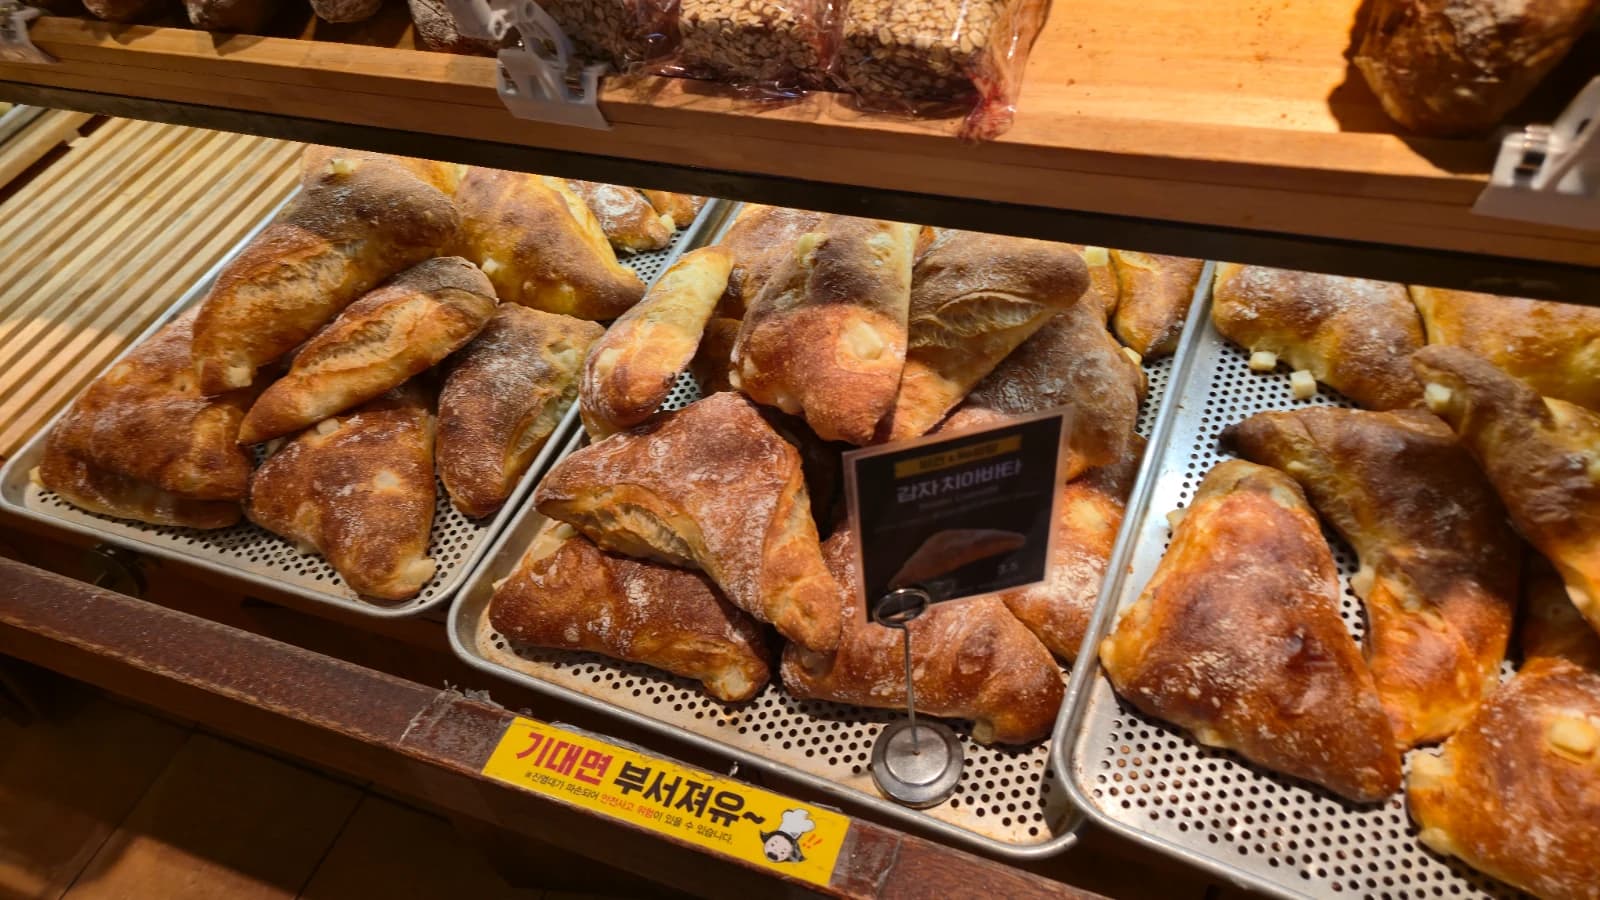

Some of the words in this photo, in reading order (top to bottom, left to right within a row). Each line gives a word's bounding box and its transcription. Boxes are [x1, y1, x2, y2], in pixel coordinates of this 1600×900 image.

[941, 458, 1022, 491] 치아바타
[516, 732, 613, 786] 기대면
[566, 782, 600, 800] 파손되어
[601, 793, 634, 811] 안전사고
[665, 814, 683, 828] 있을
[686, 821, 695, 831] 수
